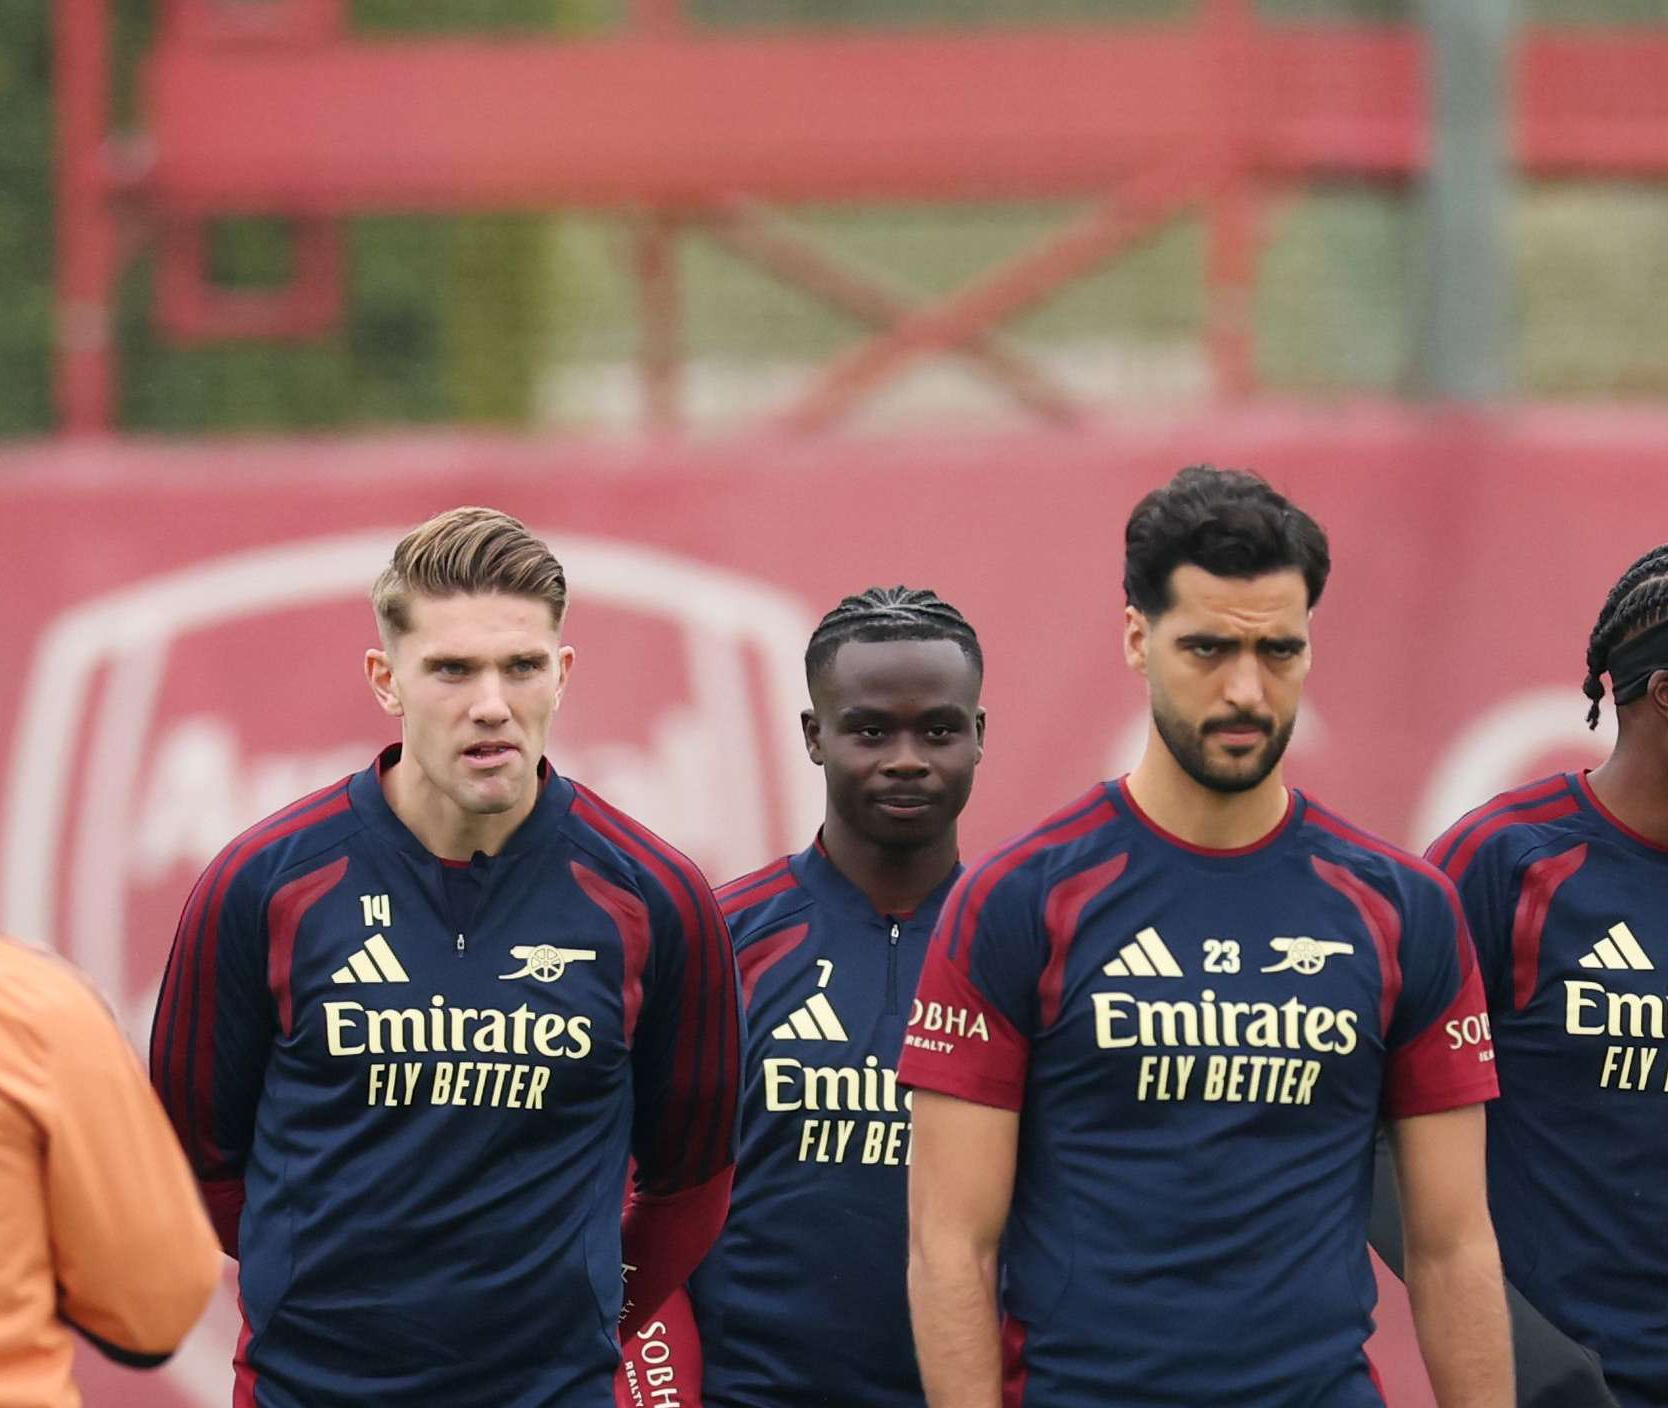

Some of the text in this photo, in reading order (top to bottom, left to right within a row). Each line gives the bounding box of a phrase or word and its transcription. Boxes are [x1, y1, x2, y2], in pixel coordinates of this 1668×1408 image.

[360, 895, 392, 927] 14
[816, 959, 833, 988] 7
[1202, 939, 1241, 974] 23
[323, 994, 592, 1059] Emirates
[908, 998, 989, 1042] OBHA
[1090, 989, 1357, 1055] Emirates
[368, 1062, 551, 1109] FLY BETTER
[1137, 1055, 1321, 1105] FLY BETTER
[1600, 1046, 1657, 1091] FLY
[798, 1119, 855, 1163] FLY
[625, 1361, 644, 1407] REALTY
